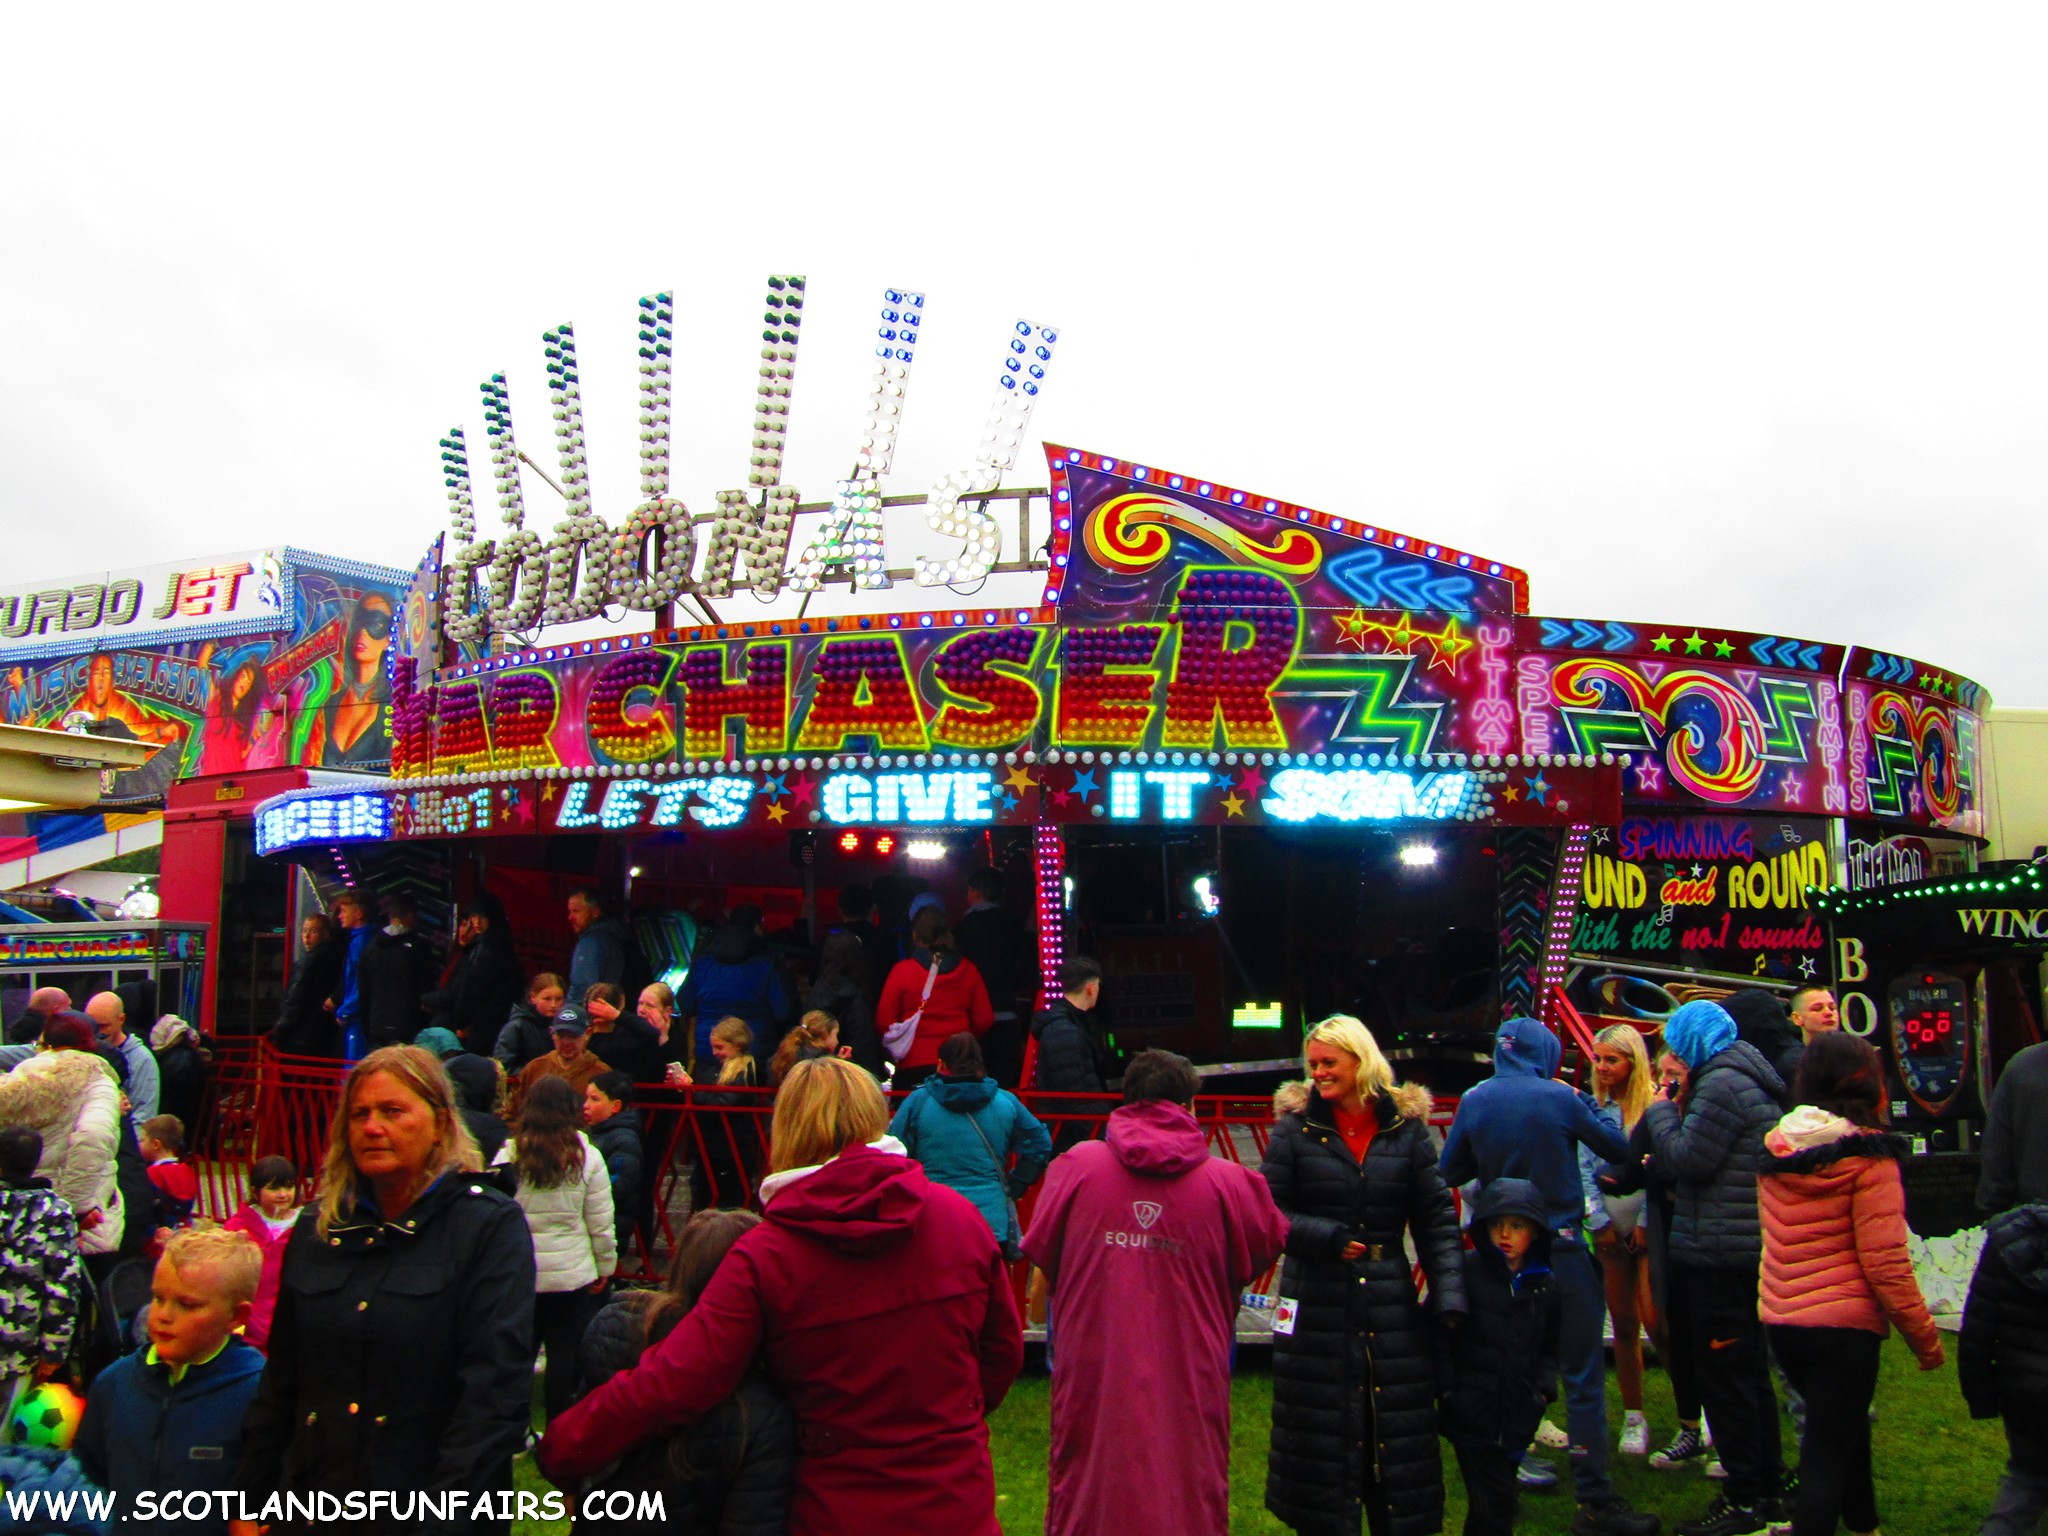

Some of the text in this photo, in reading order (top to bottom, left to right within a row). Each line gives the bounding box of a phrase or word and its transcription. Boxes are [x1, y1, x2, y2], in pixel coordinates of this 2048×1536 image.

[0, 561, 254, 638] URBO JET
[8, 652, 212, 725] MUSIC EXPLOSION
[267, 625, 337, 694] EXTREME
[586, 564, 1290, 762] CHASER
[1816, 681, 1845, 811] PUMPIN
[1849, 689, 1867, 811] BASS
[557, 778, 754, 829] LETS
[822, 771, 993, 823] GIVE
[1110, 771, 1210, 821] IT
[1618, 817, 1753, 863] SPINNING
[1660, 865, 1718, 907] and
[1728, 840, 1828, 910] ROUND
[1631, 912, 1672, 950] the
[1681, 911, 1731, 950] no.1
[1738, 915, 1824, 950] sounds
